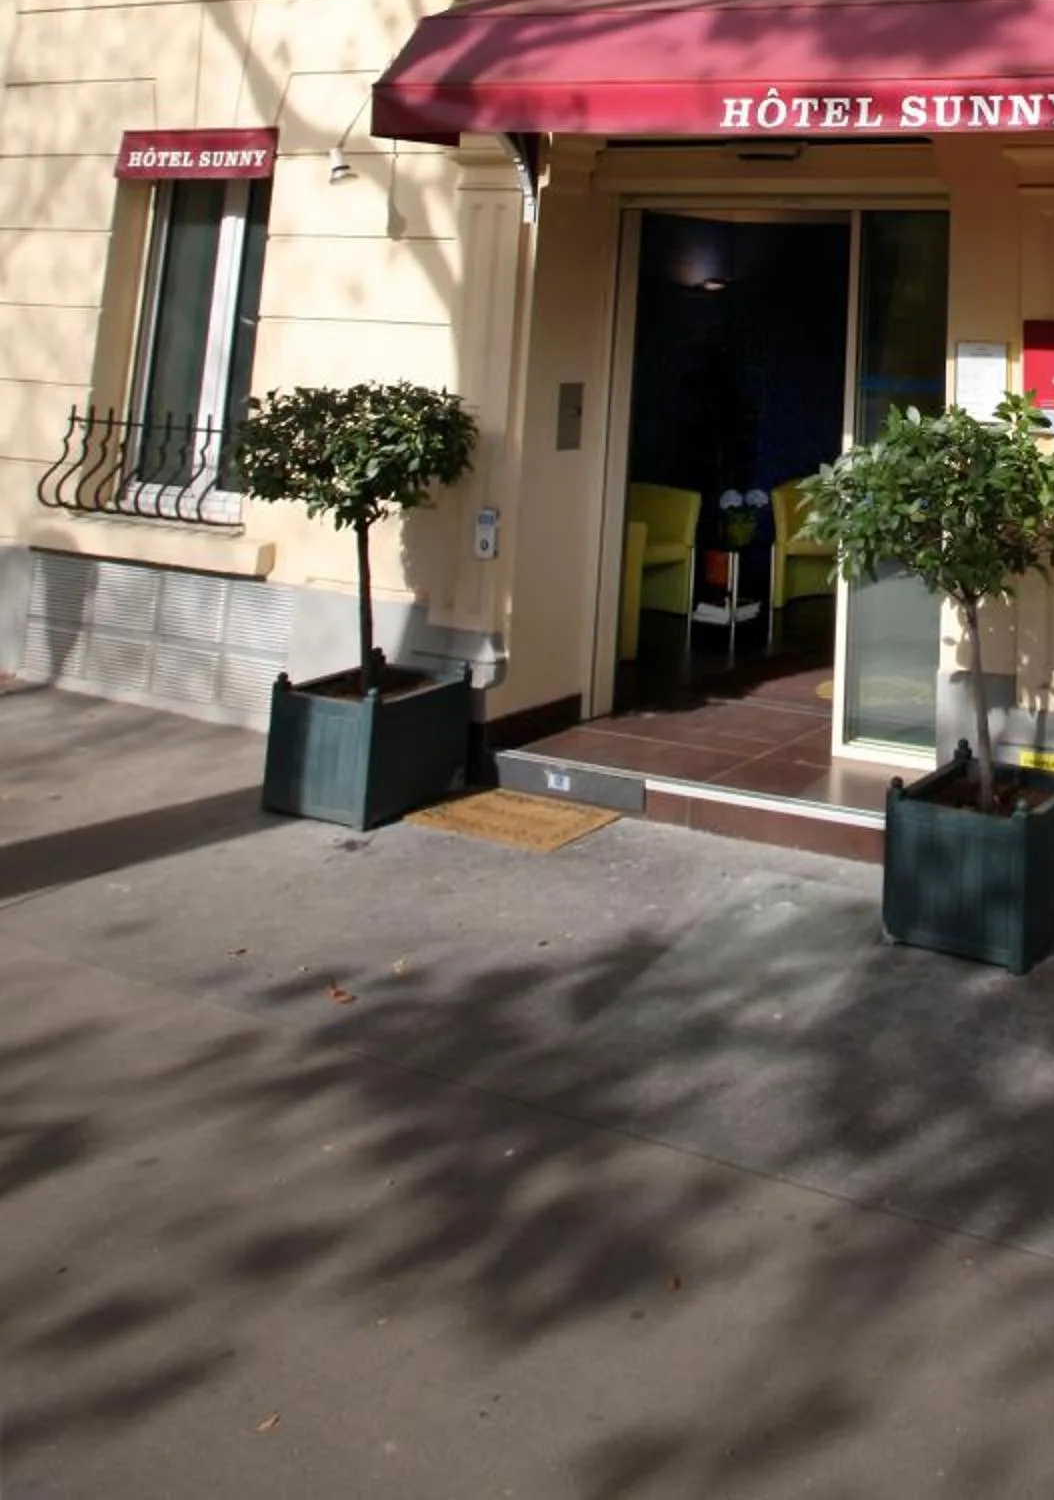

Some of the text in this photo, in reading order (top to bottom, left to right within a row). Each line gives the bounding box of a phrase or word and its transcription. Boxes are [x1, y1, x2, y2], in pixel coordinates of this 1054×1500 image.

[720, 88, 882, 127] HÔTEL
[128, 148, 266, 167] HÔTEL SUNNY
